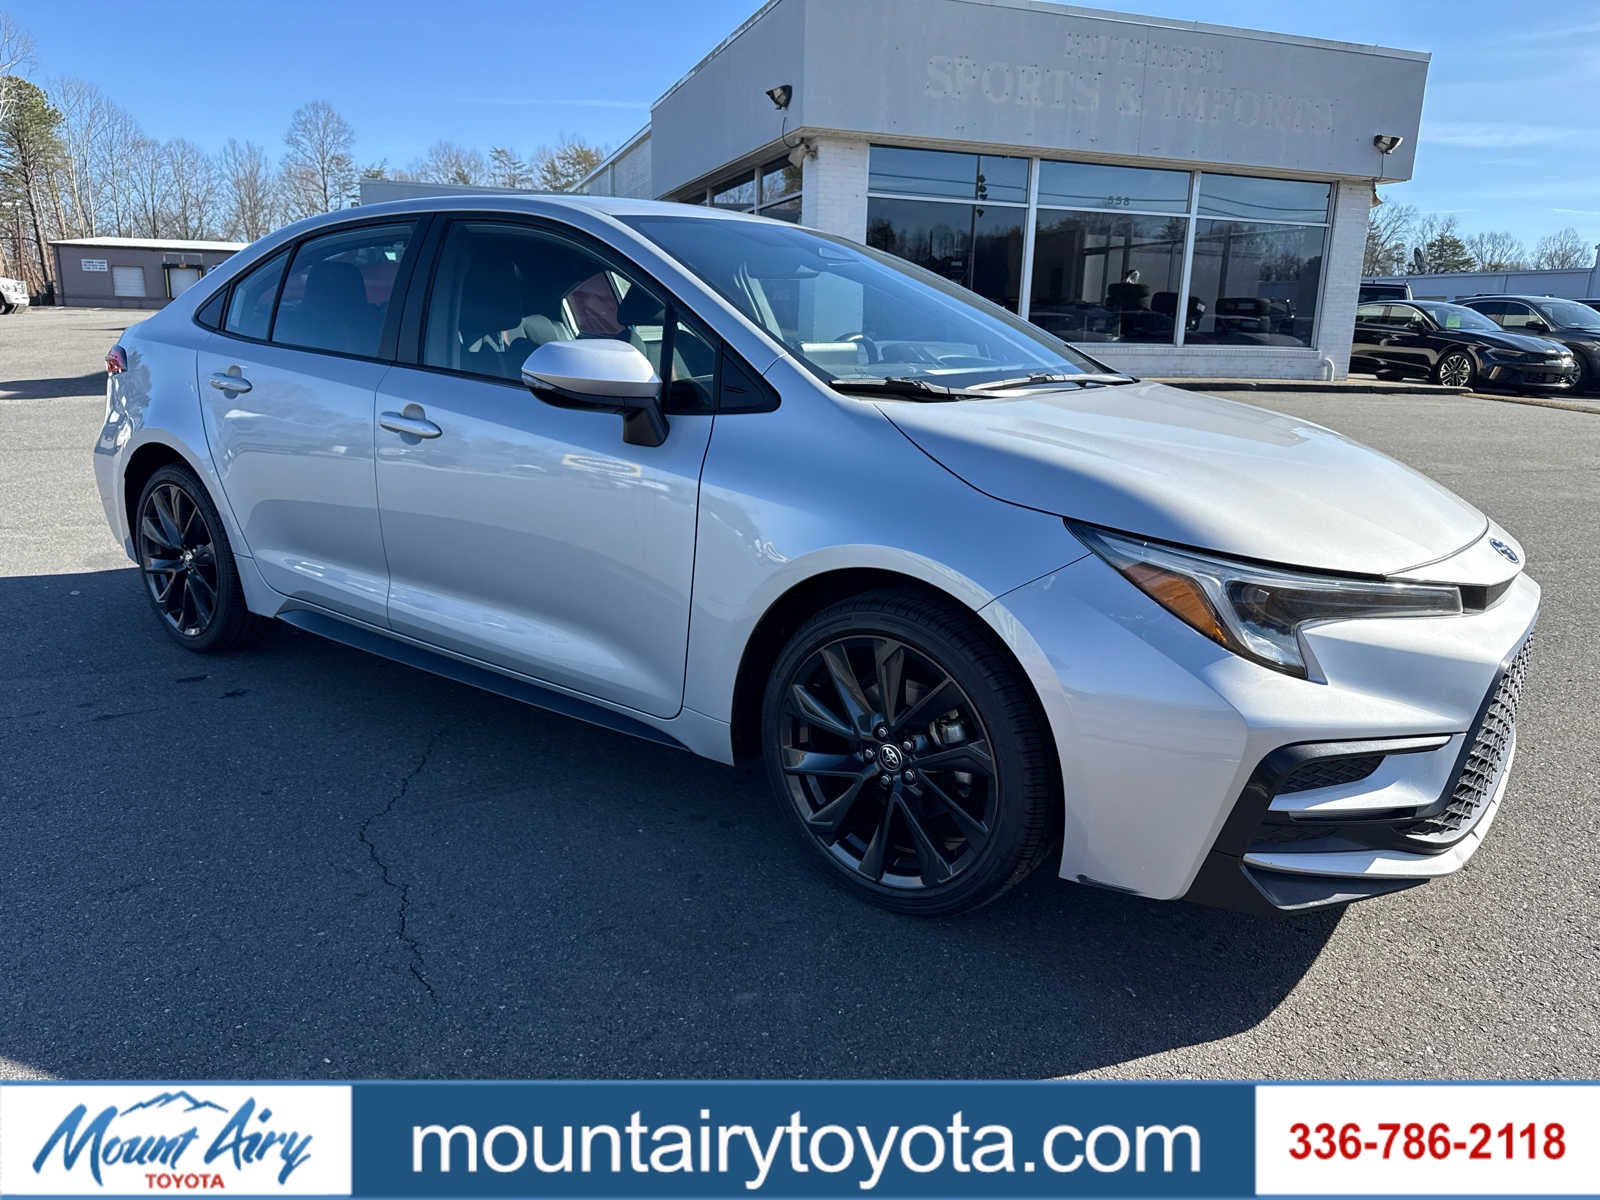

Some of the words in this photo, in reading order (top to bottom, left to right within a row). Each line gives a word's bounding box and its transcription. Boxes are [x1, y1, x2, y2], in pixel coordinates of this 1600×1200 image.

[923, 55, 1101, 111] SPORTS
[1115, 77, 1145, 117] &
[1161, 84, 1335, 136] IMPORTS
